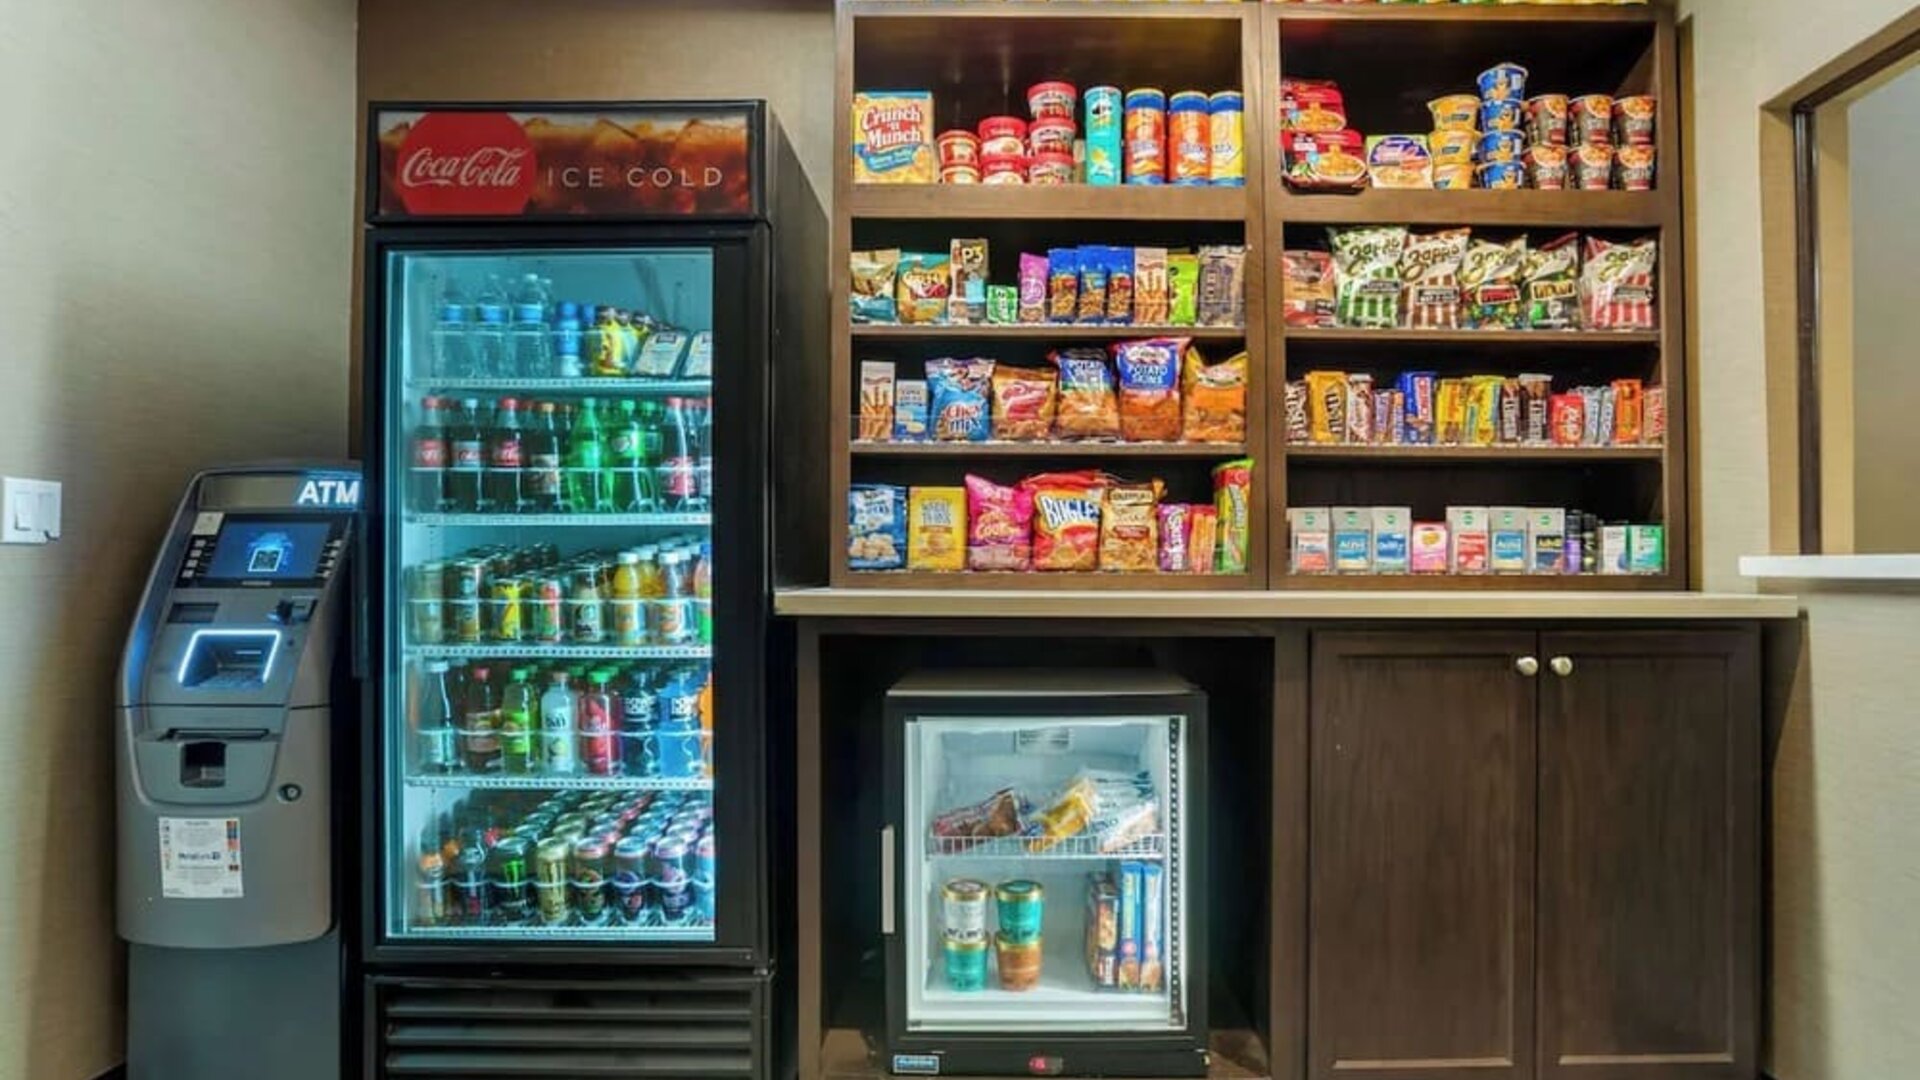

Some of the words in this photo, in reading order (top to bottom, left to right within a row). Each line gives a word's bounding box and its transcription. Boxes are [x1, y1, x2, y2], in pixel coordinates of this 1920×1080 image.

[862, 105, 921, 130] Crunch
[867, 126, 921, 152] Munch
[402, 147, 527, 188] Coca-Cola
[548, 167, 604, 187] ICE
[626, 167, 723, 187] COLD
[962, 246, 984, 264] P3
[297, 480, 361, 505] ATM
